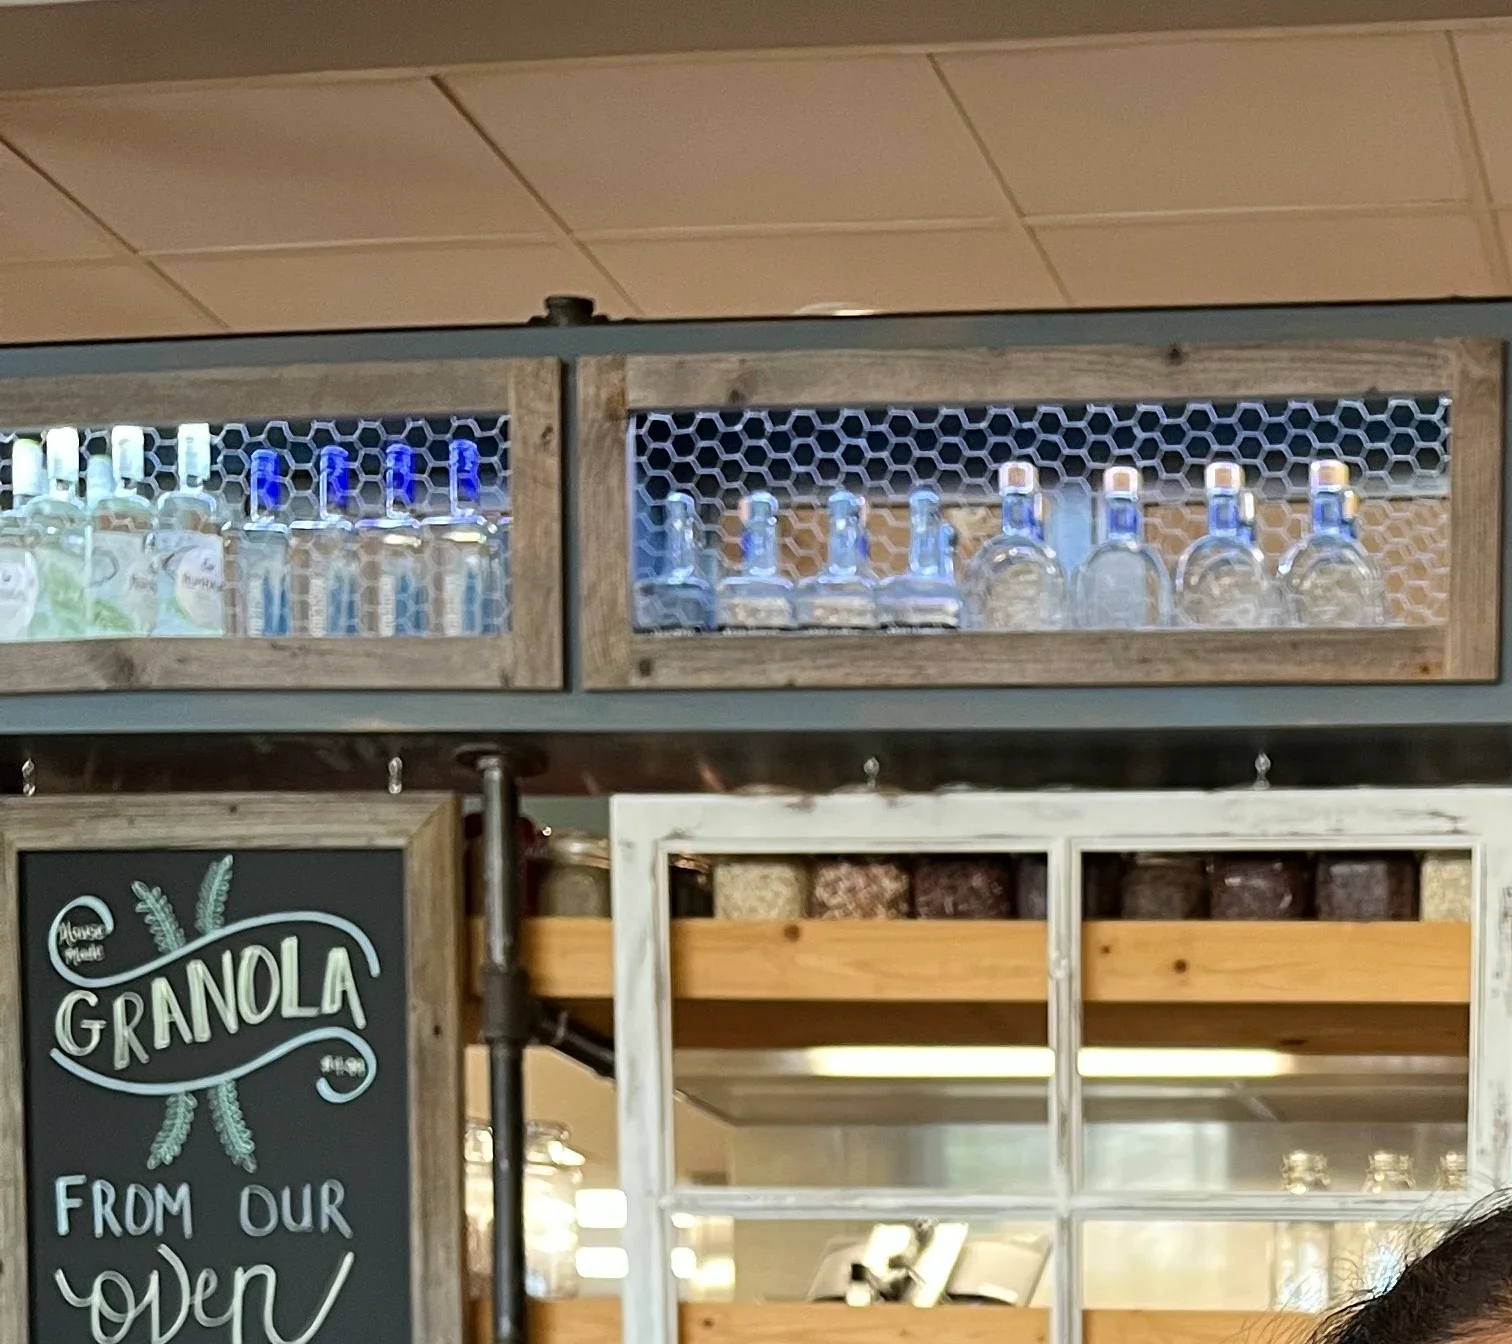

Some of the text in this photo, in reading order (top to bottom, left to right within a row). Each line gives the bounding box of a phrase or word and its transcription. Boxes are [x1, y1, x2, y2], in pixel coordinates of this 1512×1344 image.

[54, 936, 366, 1071] GRANOLA
[55, 1174, 353, 1240] FROM OUR
